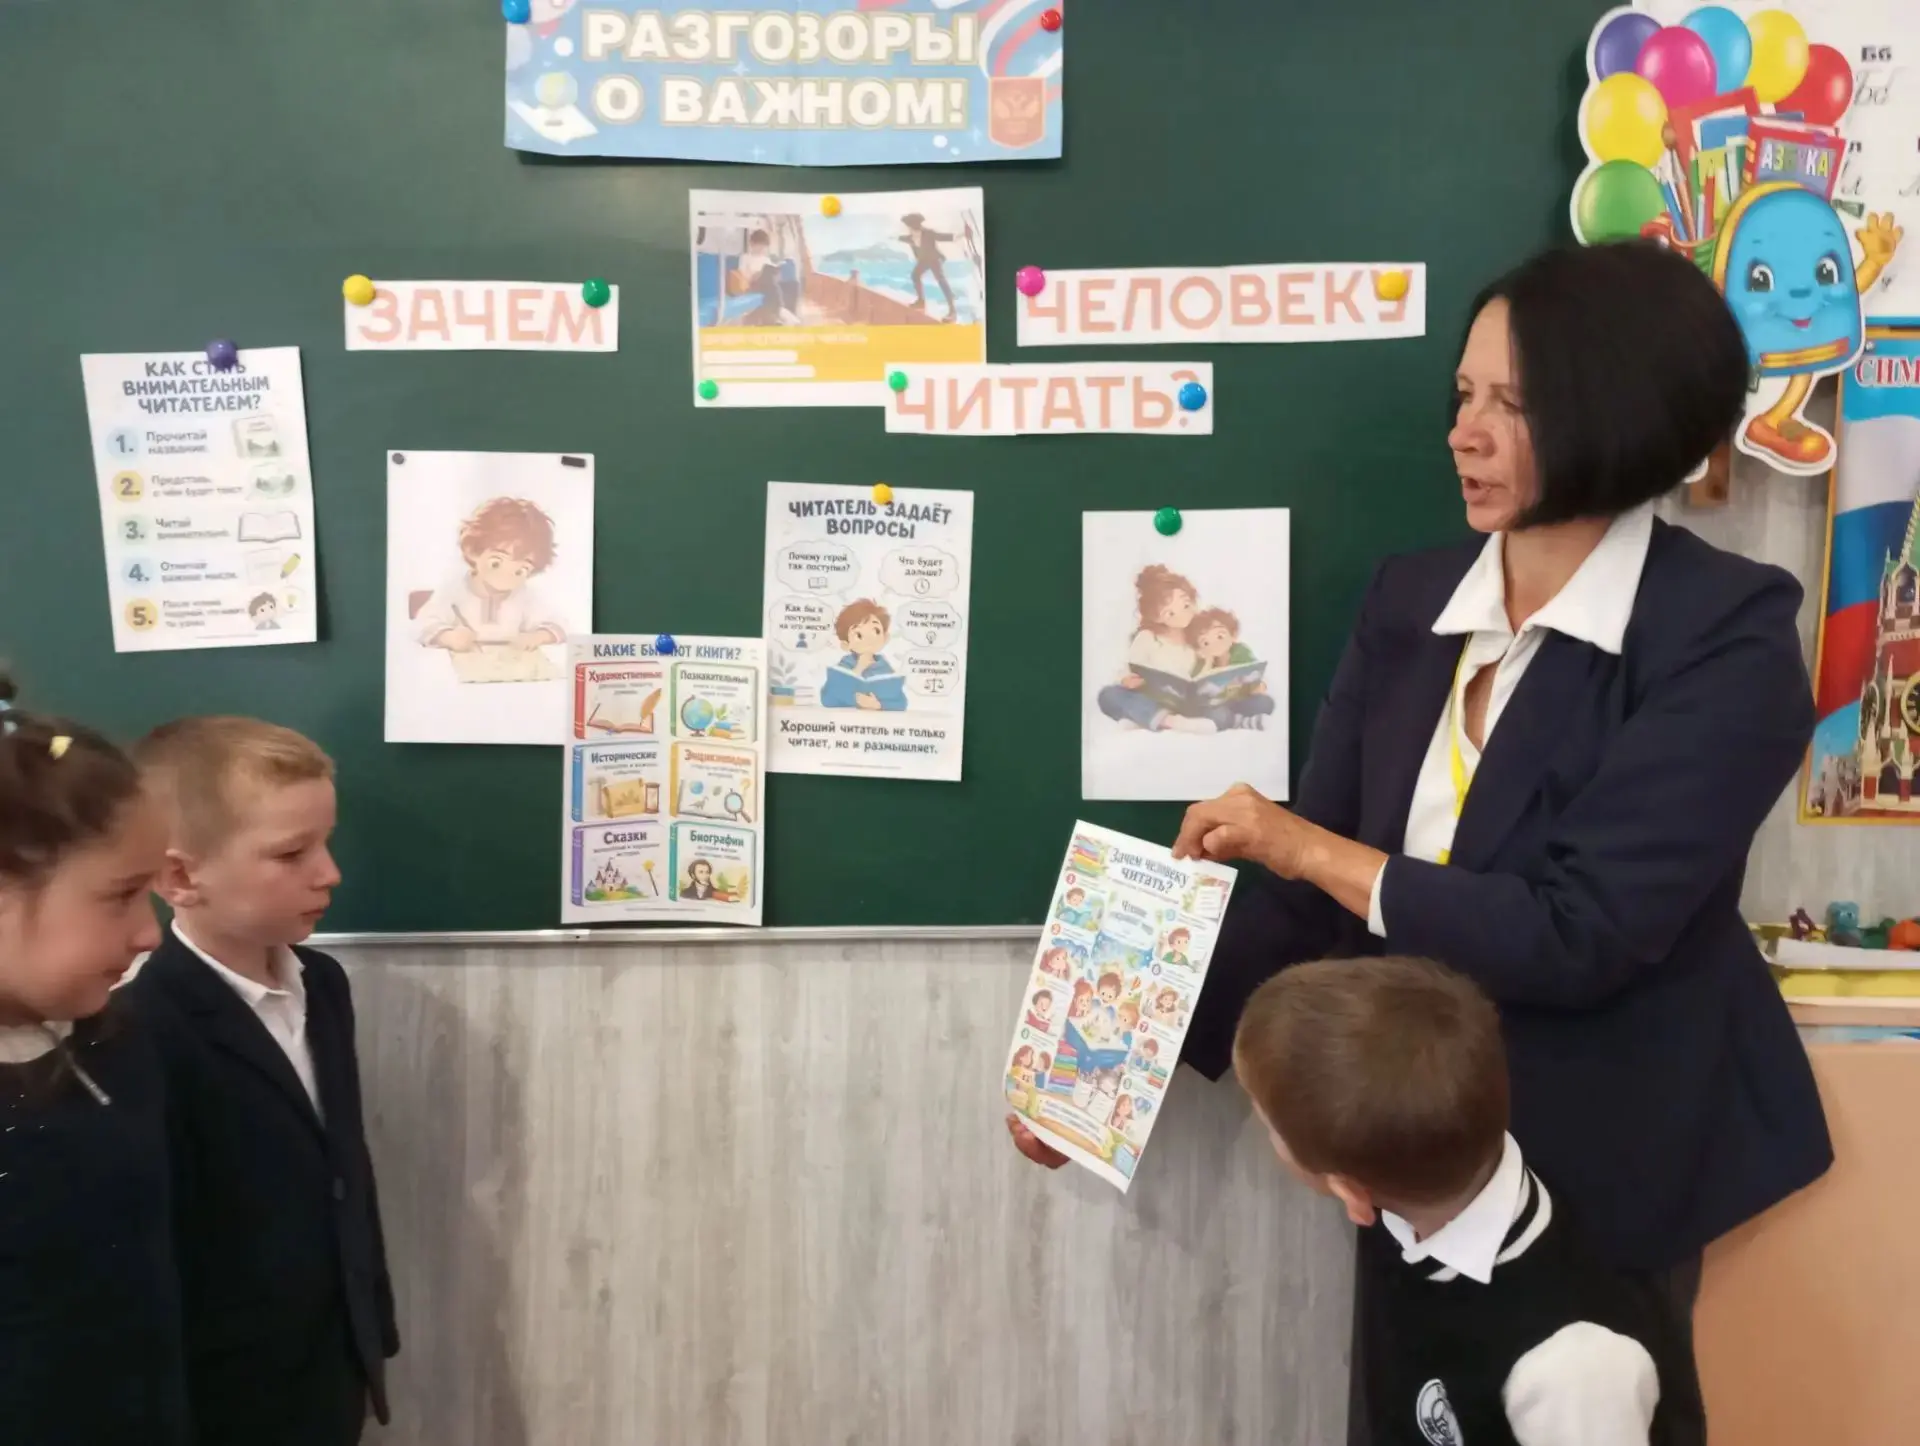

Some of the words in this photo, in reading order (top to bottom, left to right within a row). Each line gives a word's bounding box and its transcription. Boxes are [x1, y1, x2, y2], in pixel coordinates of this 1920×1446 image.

[583, 11, 979, 64] РАЗГОВОРЫ
[595, 77, 642, 122] О
[662, 78, 968, 126] ВАЖНОМ!
[1027, 269, 1413, 333] ЧЕЛОВЕКУ
[358, 288, 604, 344] ЗАЧЕМ
[144, 361, 185, 377] КАК
[192, 361, 247, 377] СТЬ
[122, 376, 271, 396] ВНИМАТЕЛЬНЫМ
[138, 394, 261, 414] ЧИТАТЕЛЕМ?
[116, 434, 135, 453] 1.
[146, 430, 208, 445] Прочитай
[120, 478, 141, 496] 2.
[788, 499, 877, 518] ЧИТАТЕЛЬ
[884, 501, 953, 526] ЗАДАЁТ
[125, 520, 145, 540] 3.
[826, 518, 916, 539] ВОПРОСЫ
[788, 551, 821, 563] Почему
[823, 553, 848, 563] герой
[898, 556, 915, 566] Что
[917, 557, 943, 568] будет
[128, 563, 150, 582] 4.
[788, 563, 803, 571] так
[806, 563, 851, 573] поступил?
[904, 567, 943, 578] дальше?
[133, 606, 154, 627] 5.
[784, 603, 801, 613] Как
[804, 605, 816, 613] бы
[909, 609, 930, 621] Чему
[593, 643, 637, 658] КАКИЕ
[640, 643, 692, 659] БЫЮТ
[695, 645, 742, 661] КНИГИ?
[588, 670, 664, 684] Художественные
[680, 669, 750, 685] Познавательные
[780, 719, 836, 735] Хороший
[839, 724, 890, 737] читатель
[892, 727, 905, 737] не
[908, 728, 946, 740] только
[787, 737, 832, 751] читает,
[834, 740, 848, 750] но
[852, 741, 860, 750] и
[863, 741, 939, 755] размышляет.
[591, 750, 658, 764] Исторические
[603, 830, 648, 845] Сказки
[690, 829, 745, 848] Биографии
[1109, 847, 1143, 868] Зачем
[1144, 858, 1191, 890] человеку
[1120, 867, 1174, 895] читать?
